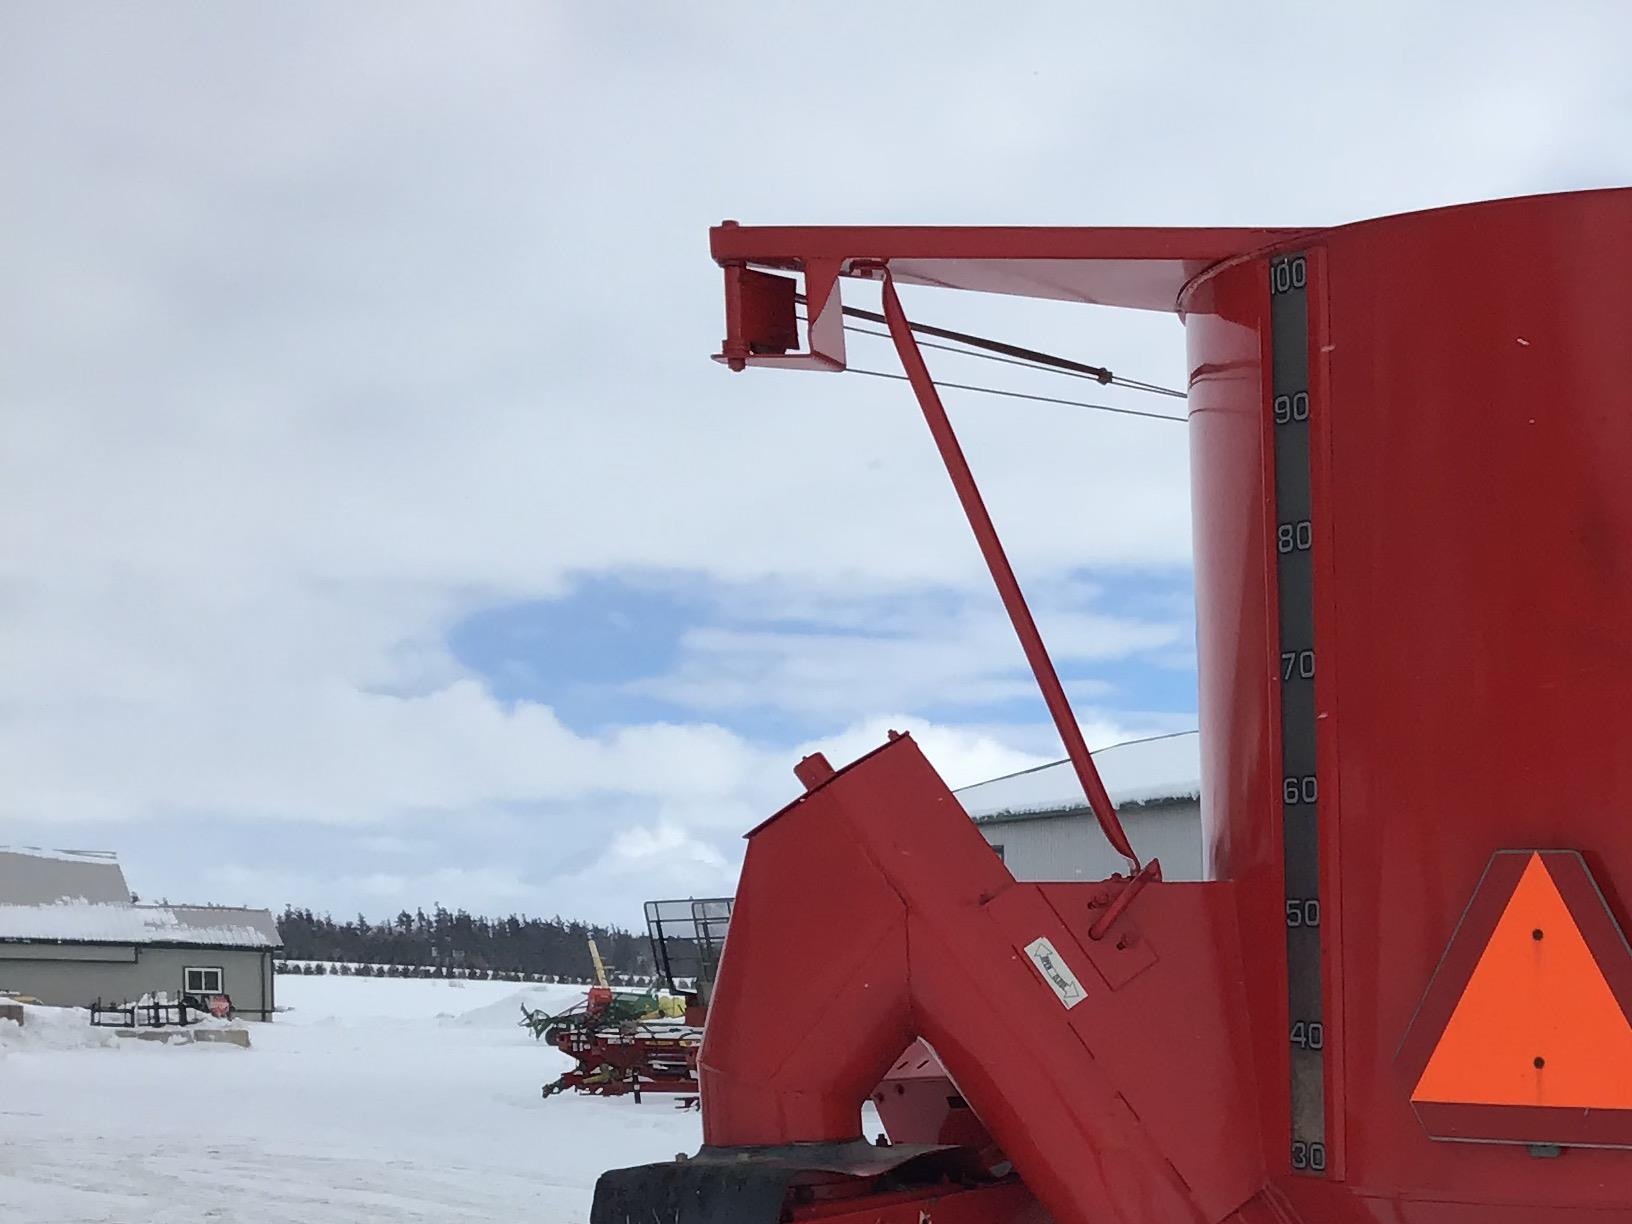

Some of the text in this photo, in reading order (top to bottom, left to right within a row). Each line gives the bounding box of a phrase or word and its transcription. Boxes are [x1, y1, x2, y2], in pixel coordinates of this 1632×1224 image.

[1271, 258, 1305, 294] 100
[1274, 392, 1310, 424] 90
[1277, 521, 1313, 553] 80
[1281, 650, 1315, 680] 70
[1283, 776, 1318, 804] 60
[1286, 900, 1320, 927] 50
[1289, 1023, 1323, 1049] 40
[1291, 1142, 1326, 1170] 30
